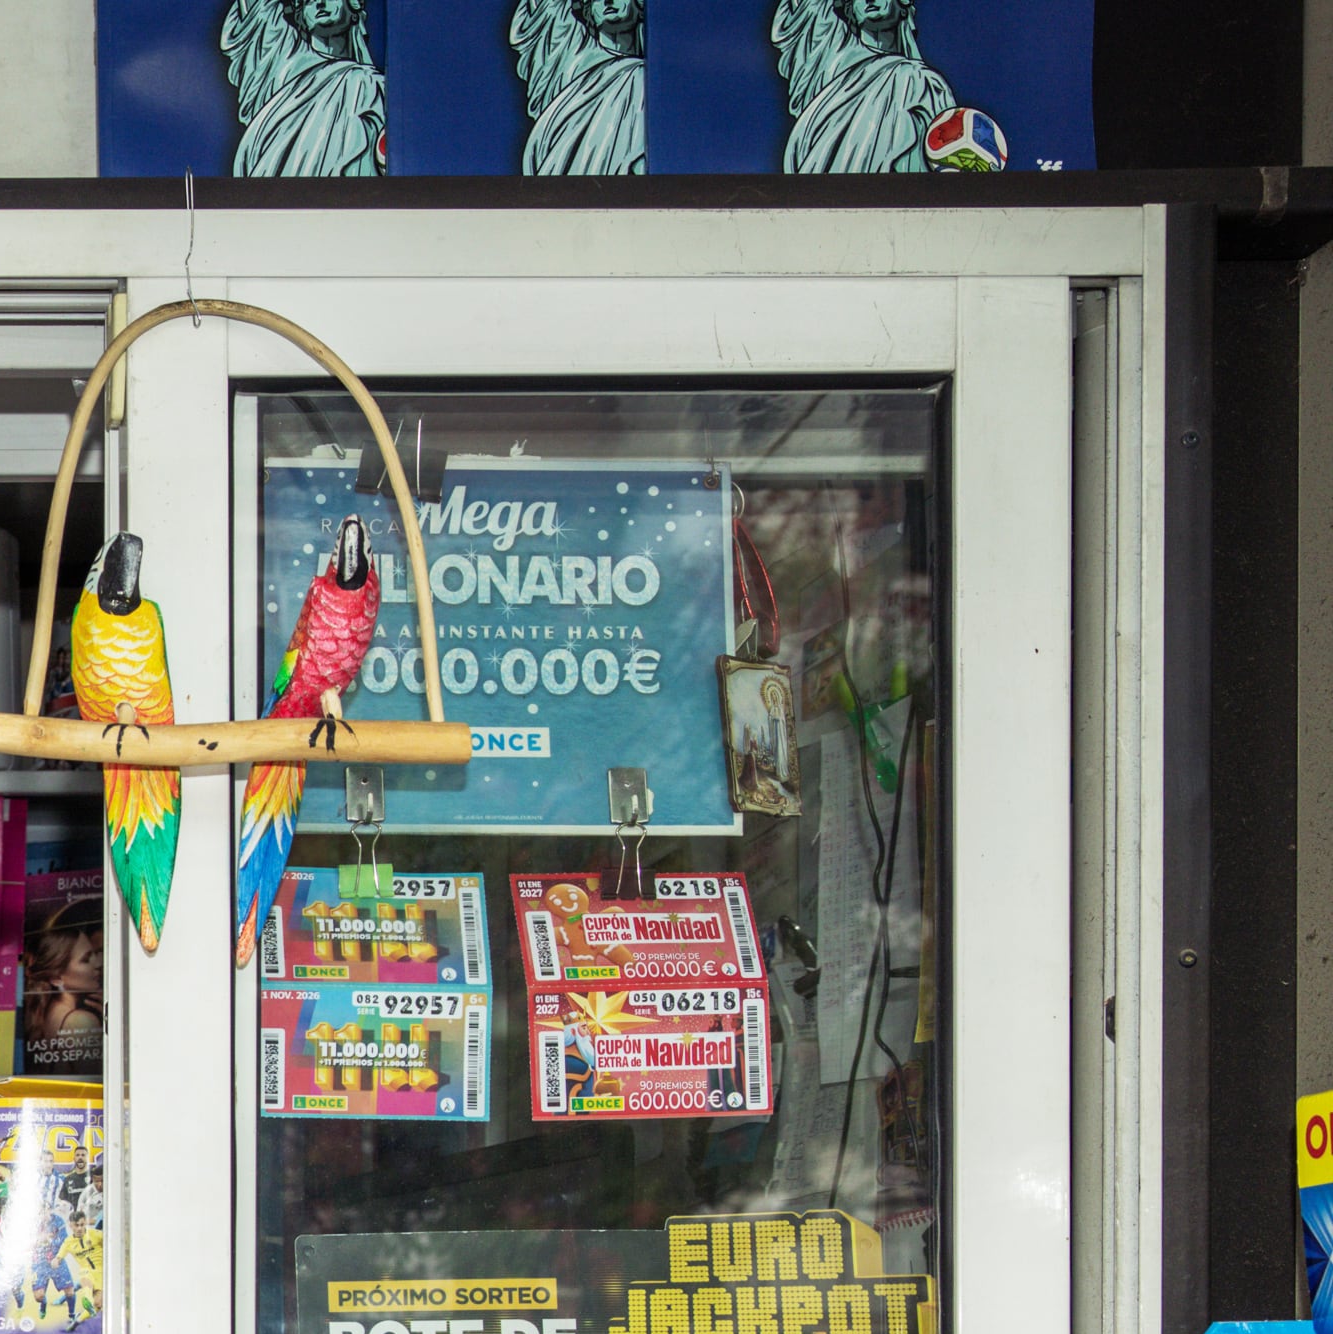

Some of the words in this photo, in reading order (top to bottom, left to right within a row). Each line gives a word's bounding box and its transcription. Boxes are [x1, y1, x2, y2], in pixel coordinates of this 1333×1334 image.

[424, 485, 560, 551] Mega
[440, 625, 555, 639] INSTANTE
[568, 625, 643, 639] HASTA
[472, 733, 542, 750] ONCE
[385, 996, 459, 1016] 92957
[661, 992, 736, 1010] 06218
[597, 1040, 642, 1056] CUPÓN
[645, 1036, 732, 1066] Navidad
[597, 1057, 629, 1069] EXTRA
[631, 1058, 641, 1068] de
[640, 1081, 653, 1090] 90
[655, 1081, 694, 1090] PREMIOS
[695, 1081, 707, 1090] DE
[669, 1218, 844, 1282] EURO
[338, 1285, 447, 1307] PRÓXIMO
[455, 1285, 551, 1305] SORTEO
